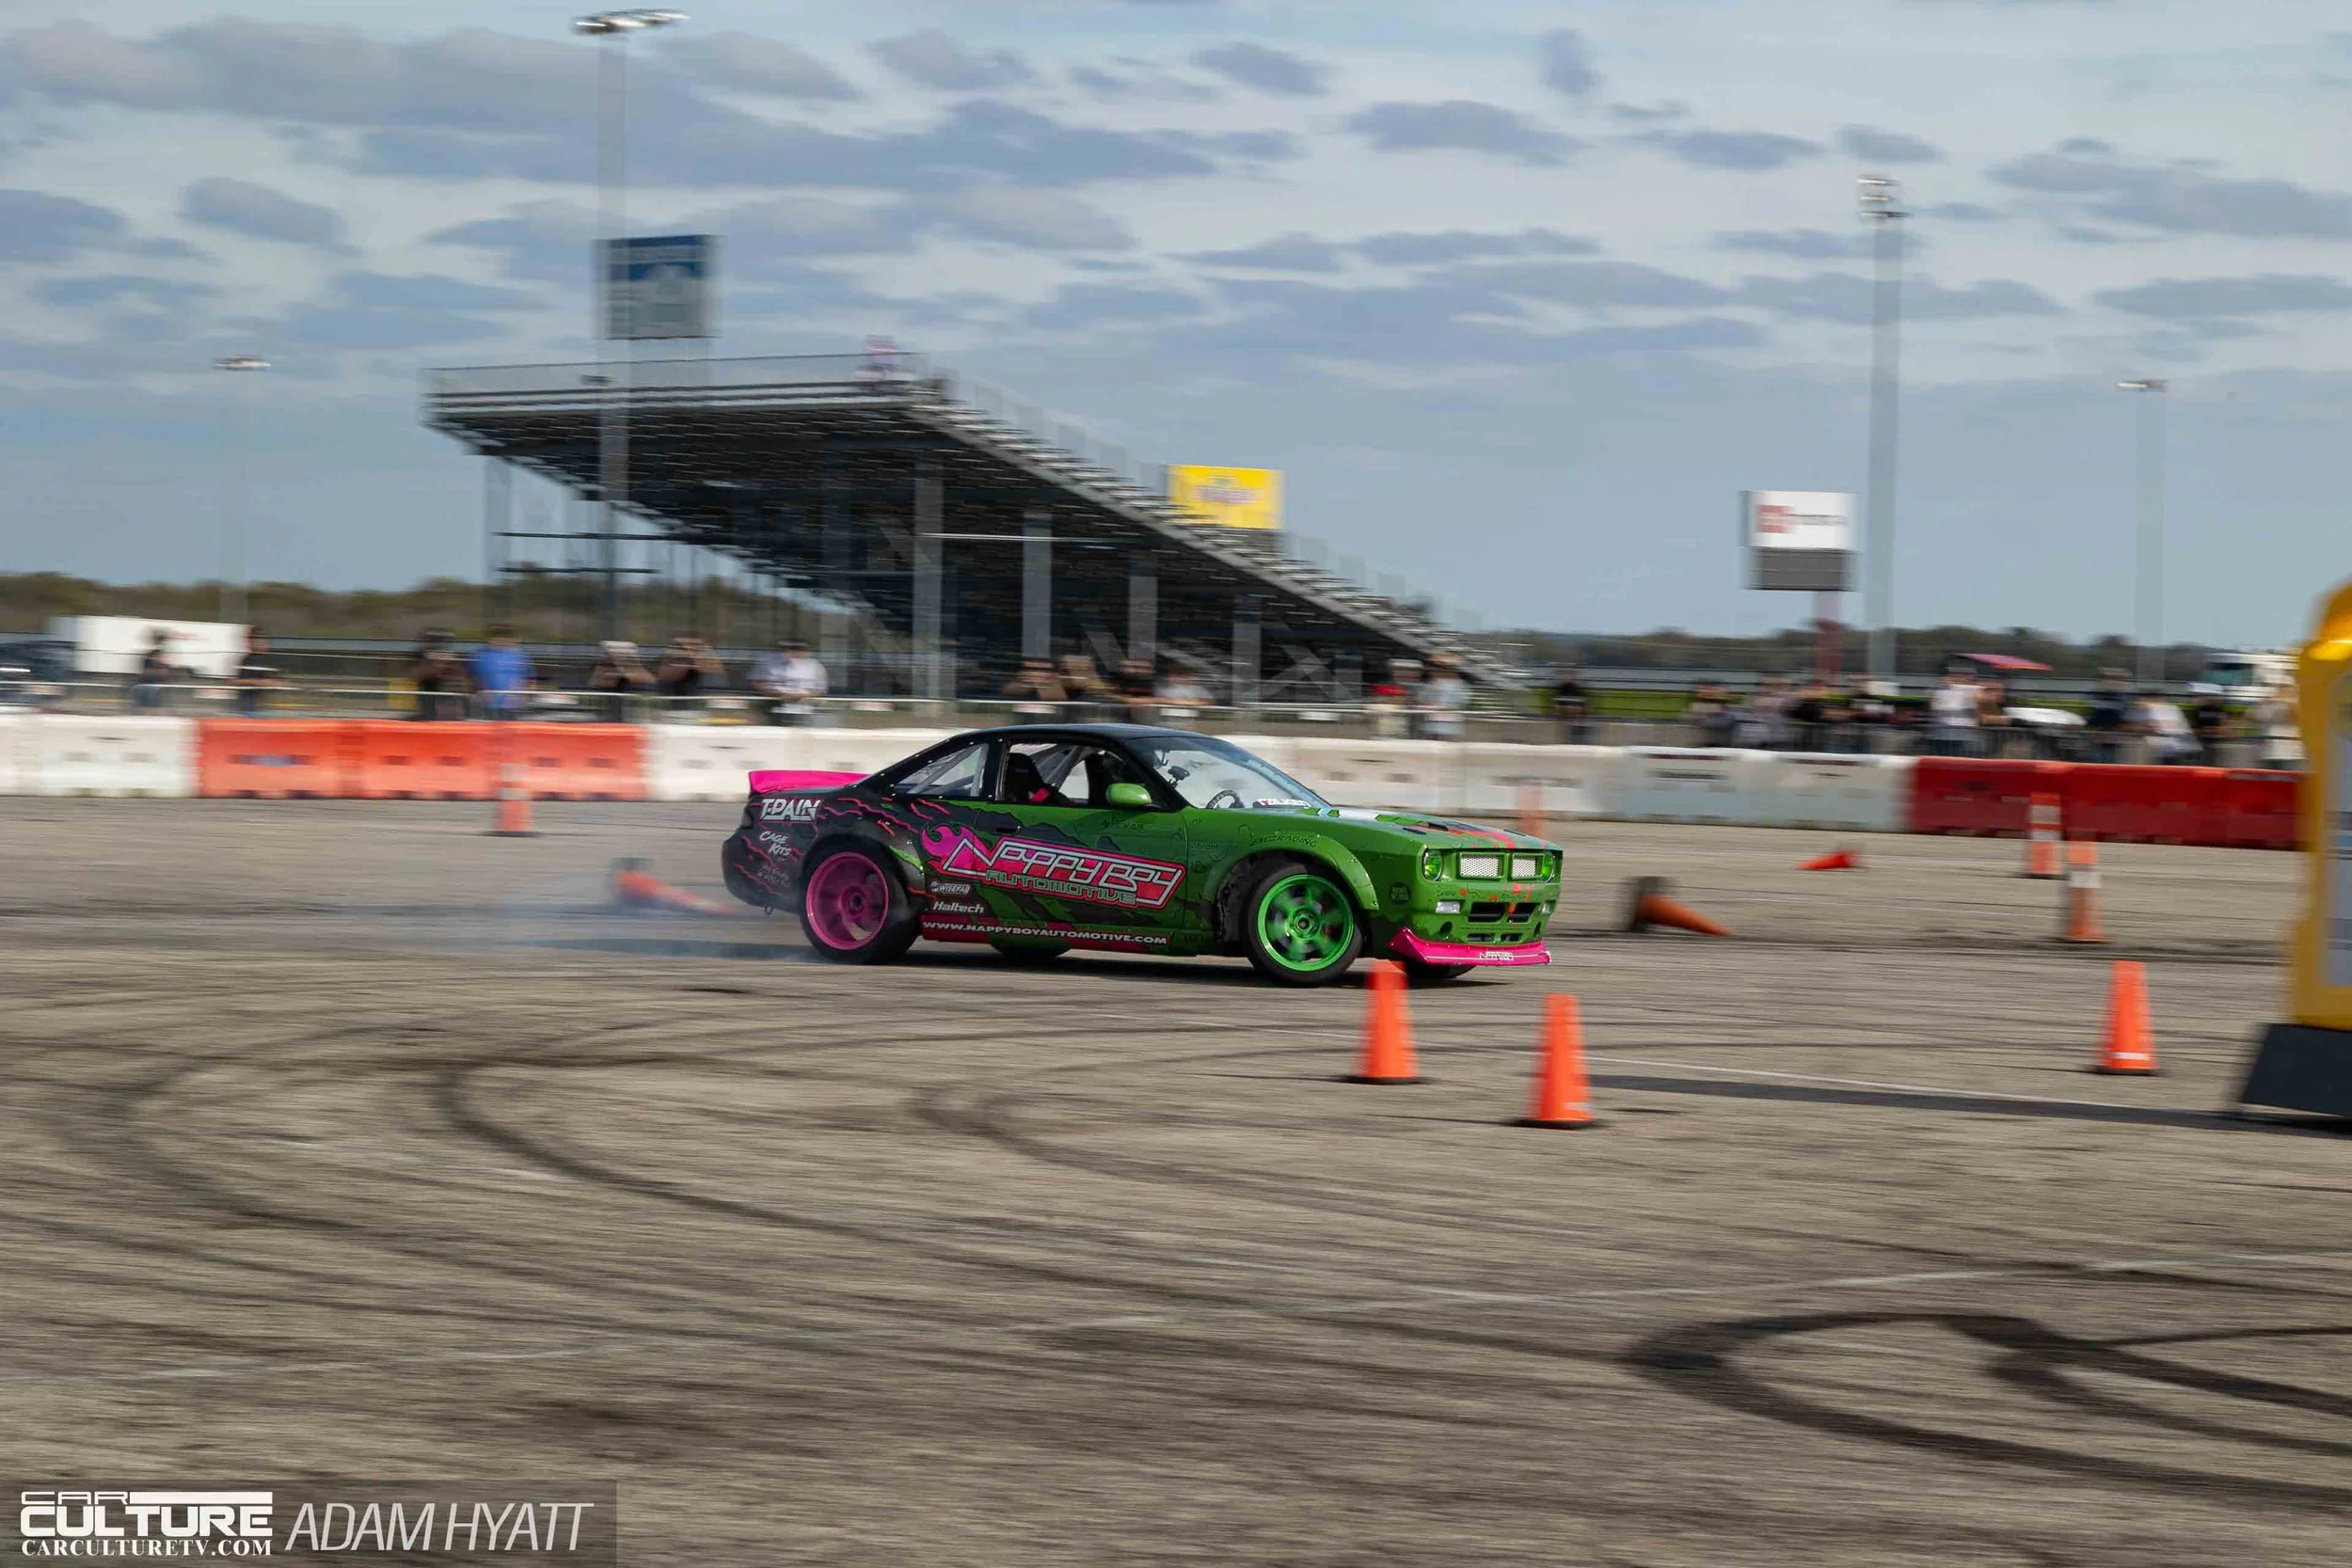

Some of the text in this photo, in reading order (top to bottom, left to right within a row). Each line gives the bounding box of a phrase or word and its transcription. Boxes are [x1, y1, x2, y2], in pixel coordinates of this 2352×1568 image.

[759, 831, 787, 844] CAGE
[985, 869, 1136, 905] AUTOMOTIVE
[933, 901, 984, 913] Haltech
[923, 922, 1167, 944] WWW.NAPPYBOYAUTOMOTIVE.COM
